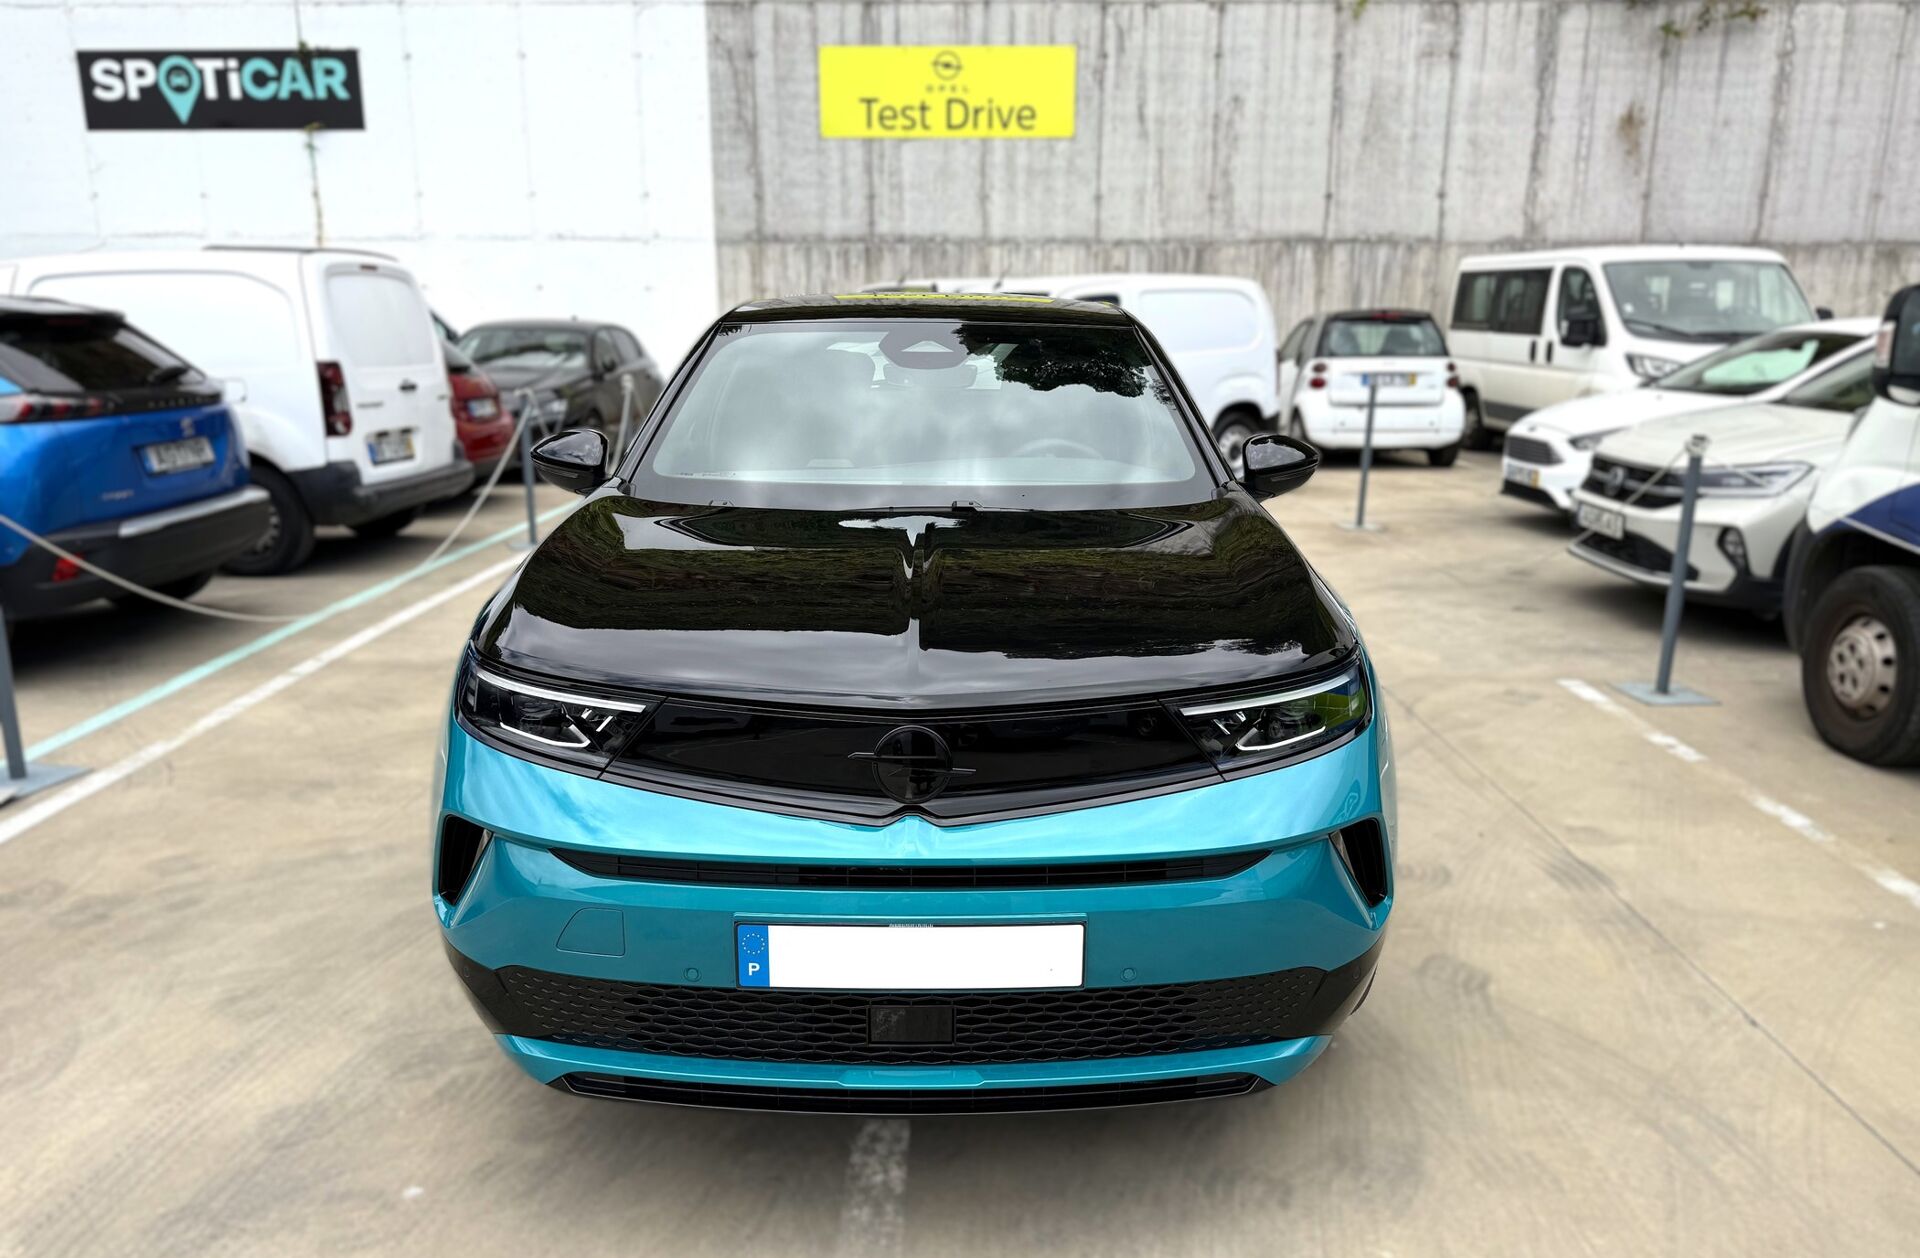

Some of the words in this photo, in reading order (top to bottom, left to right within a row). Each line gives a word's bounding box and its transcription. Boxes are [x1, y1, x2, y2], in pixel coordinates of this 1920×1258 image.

[859, 98, 931, 131] Test
[947, 98, 1037, 131] Drive
[748, 962, 760, 976] P
